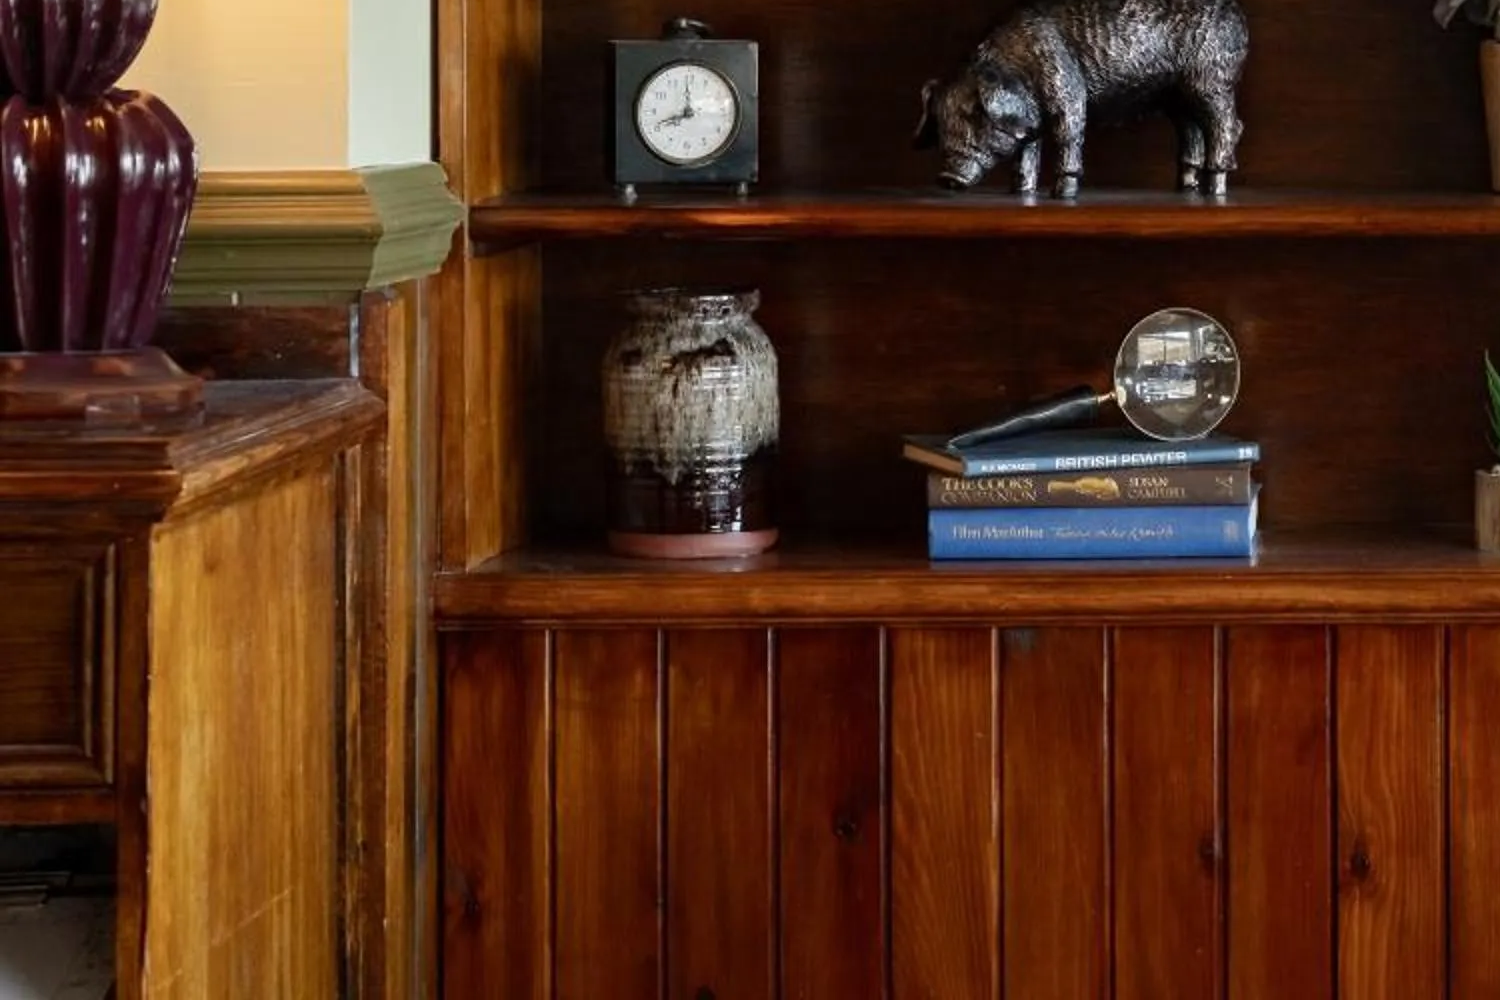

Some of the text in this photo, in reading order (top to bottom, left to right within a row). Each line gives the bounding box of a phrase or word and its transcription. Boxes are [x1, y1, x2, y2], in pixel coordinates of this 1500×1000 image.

[1055, 451, 1187, 470] BRITISH PEWTER
[942, 477, 975, 491] THE
